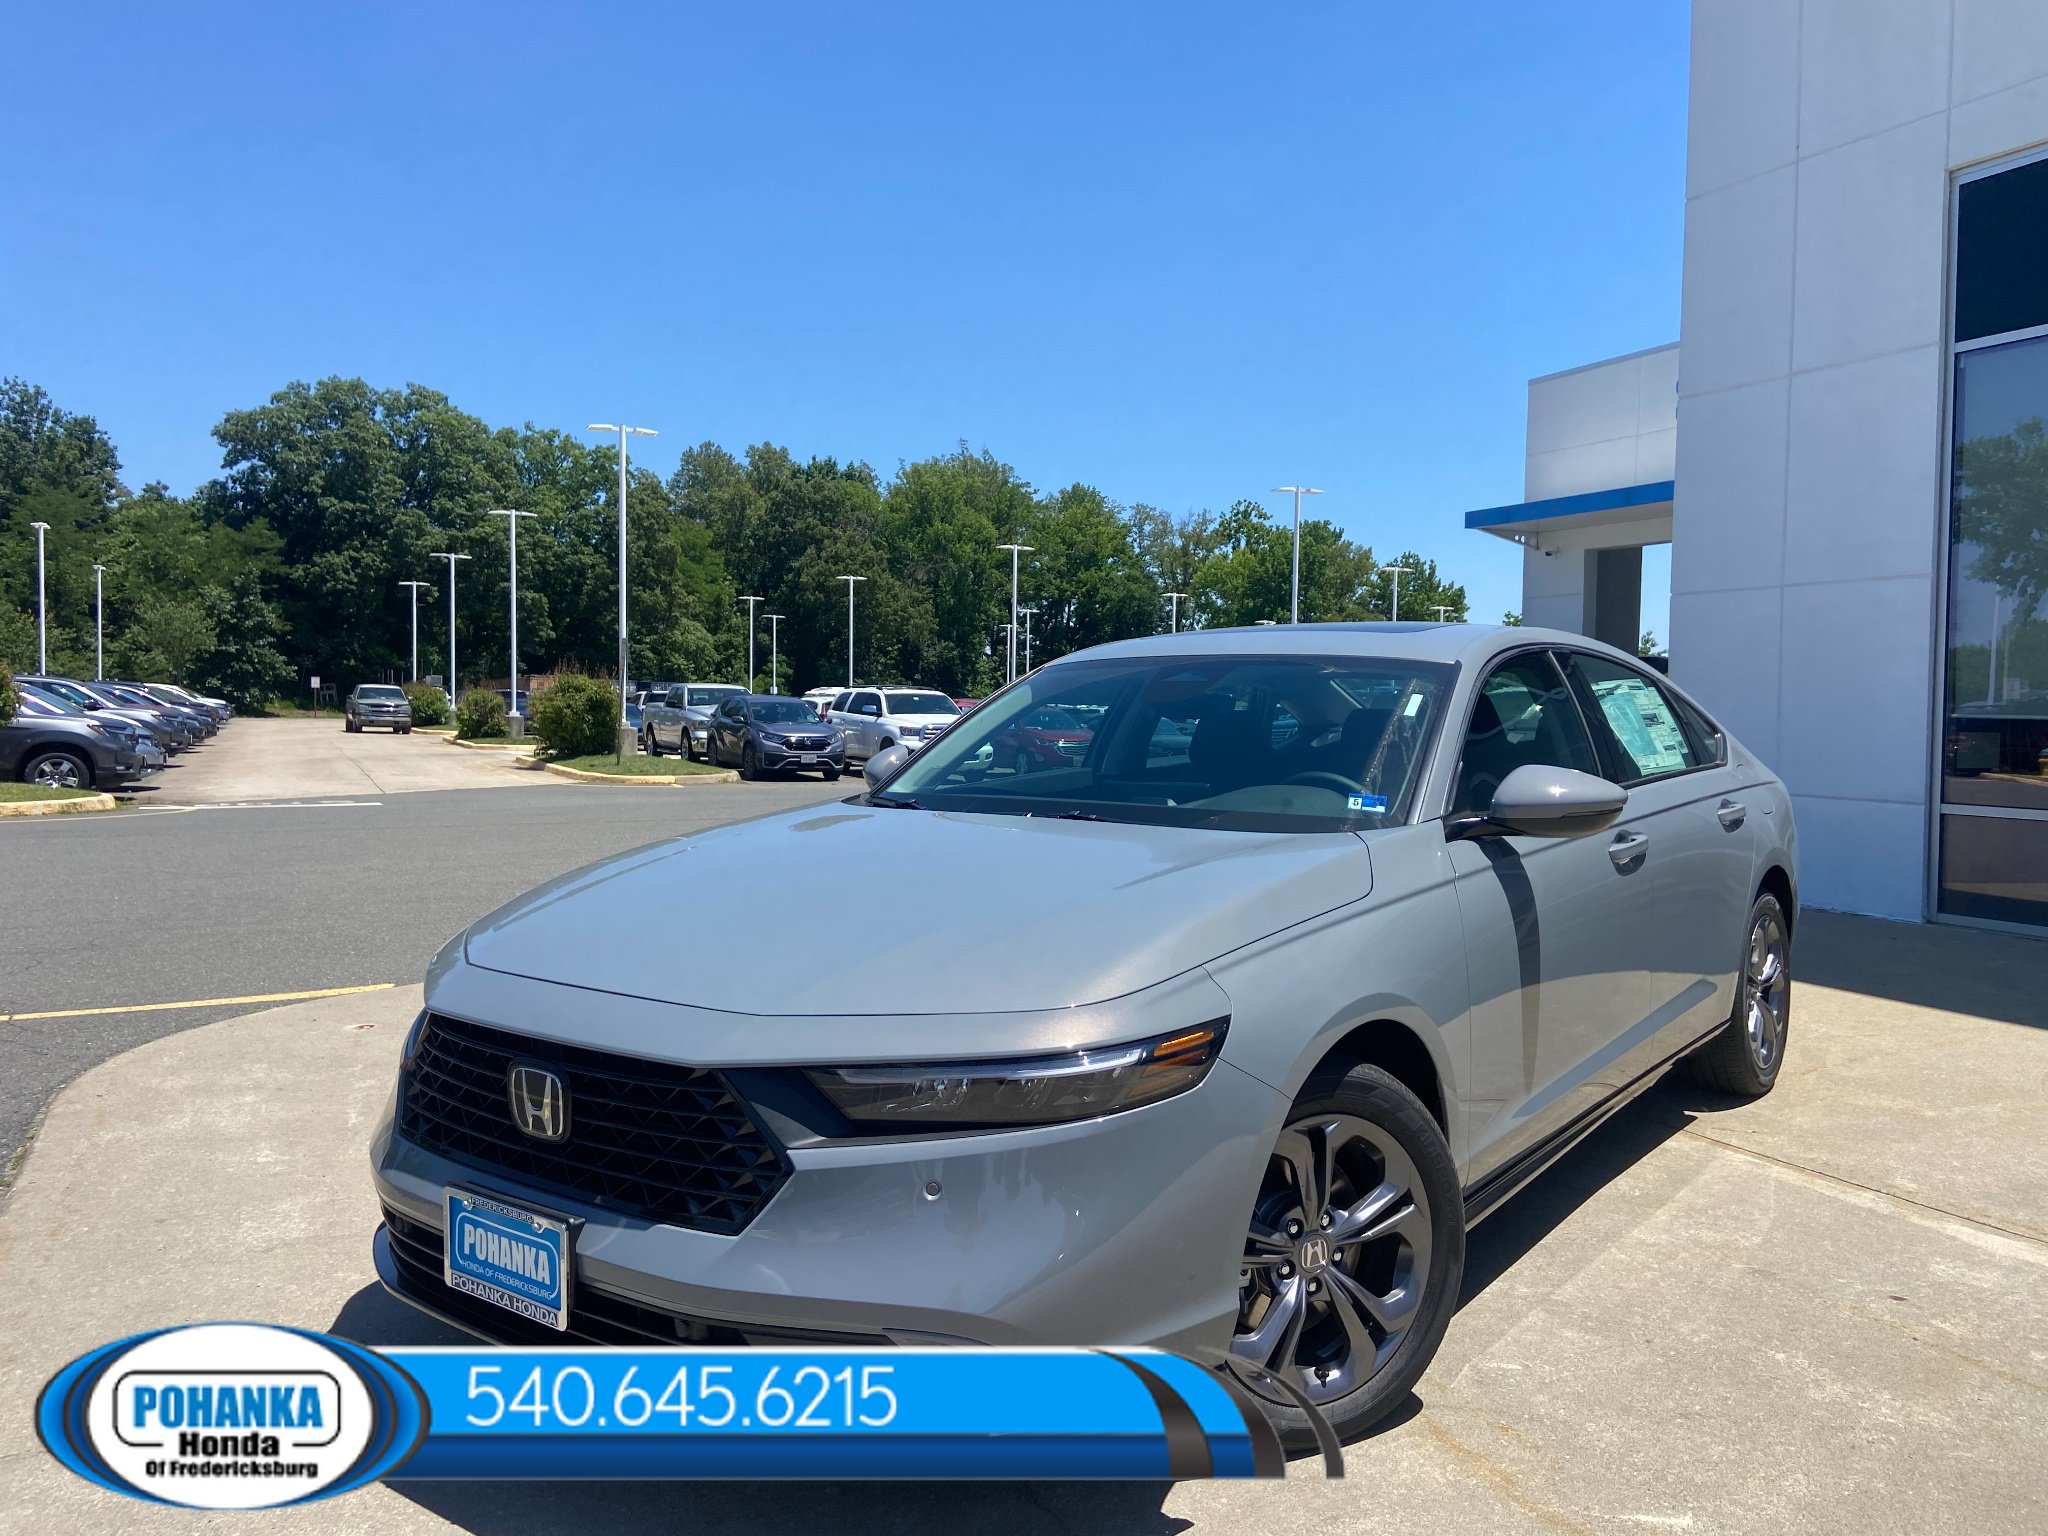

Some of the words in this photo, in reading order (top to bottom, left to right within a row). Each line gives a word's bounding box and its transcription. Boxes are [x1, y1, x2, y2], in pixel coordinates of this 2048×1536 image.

[471, 1197, 534, 1223] FREDERICKSBURG
[464, 1224, 550, 1285] POHANKA
[452, 1274, 511, 1308] POHANKA
[513, 1298, 558, 1327] HONDA
[461, 1260, 484, 1277] HONDA
[485, 1267, 494, 1277] OF
[494, 1272, 552, 1300] FREDERICKSBURG
